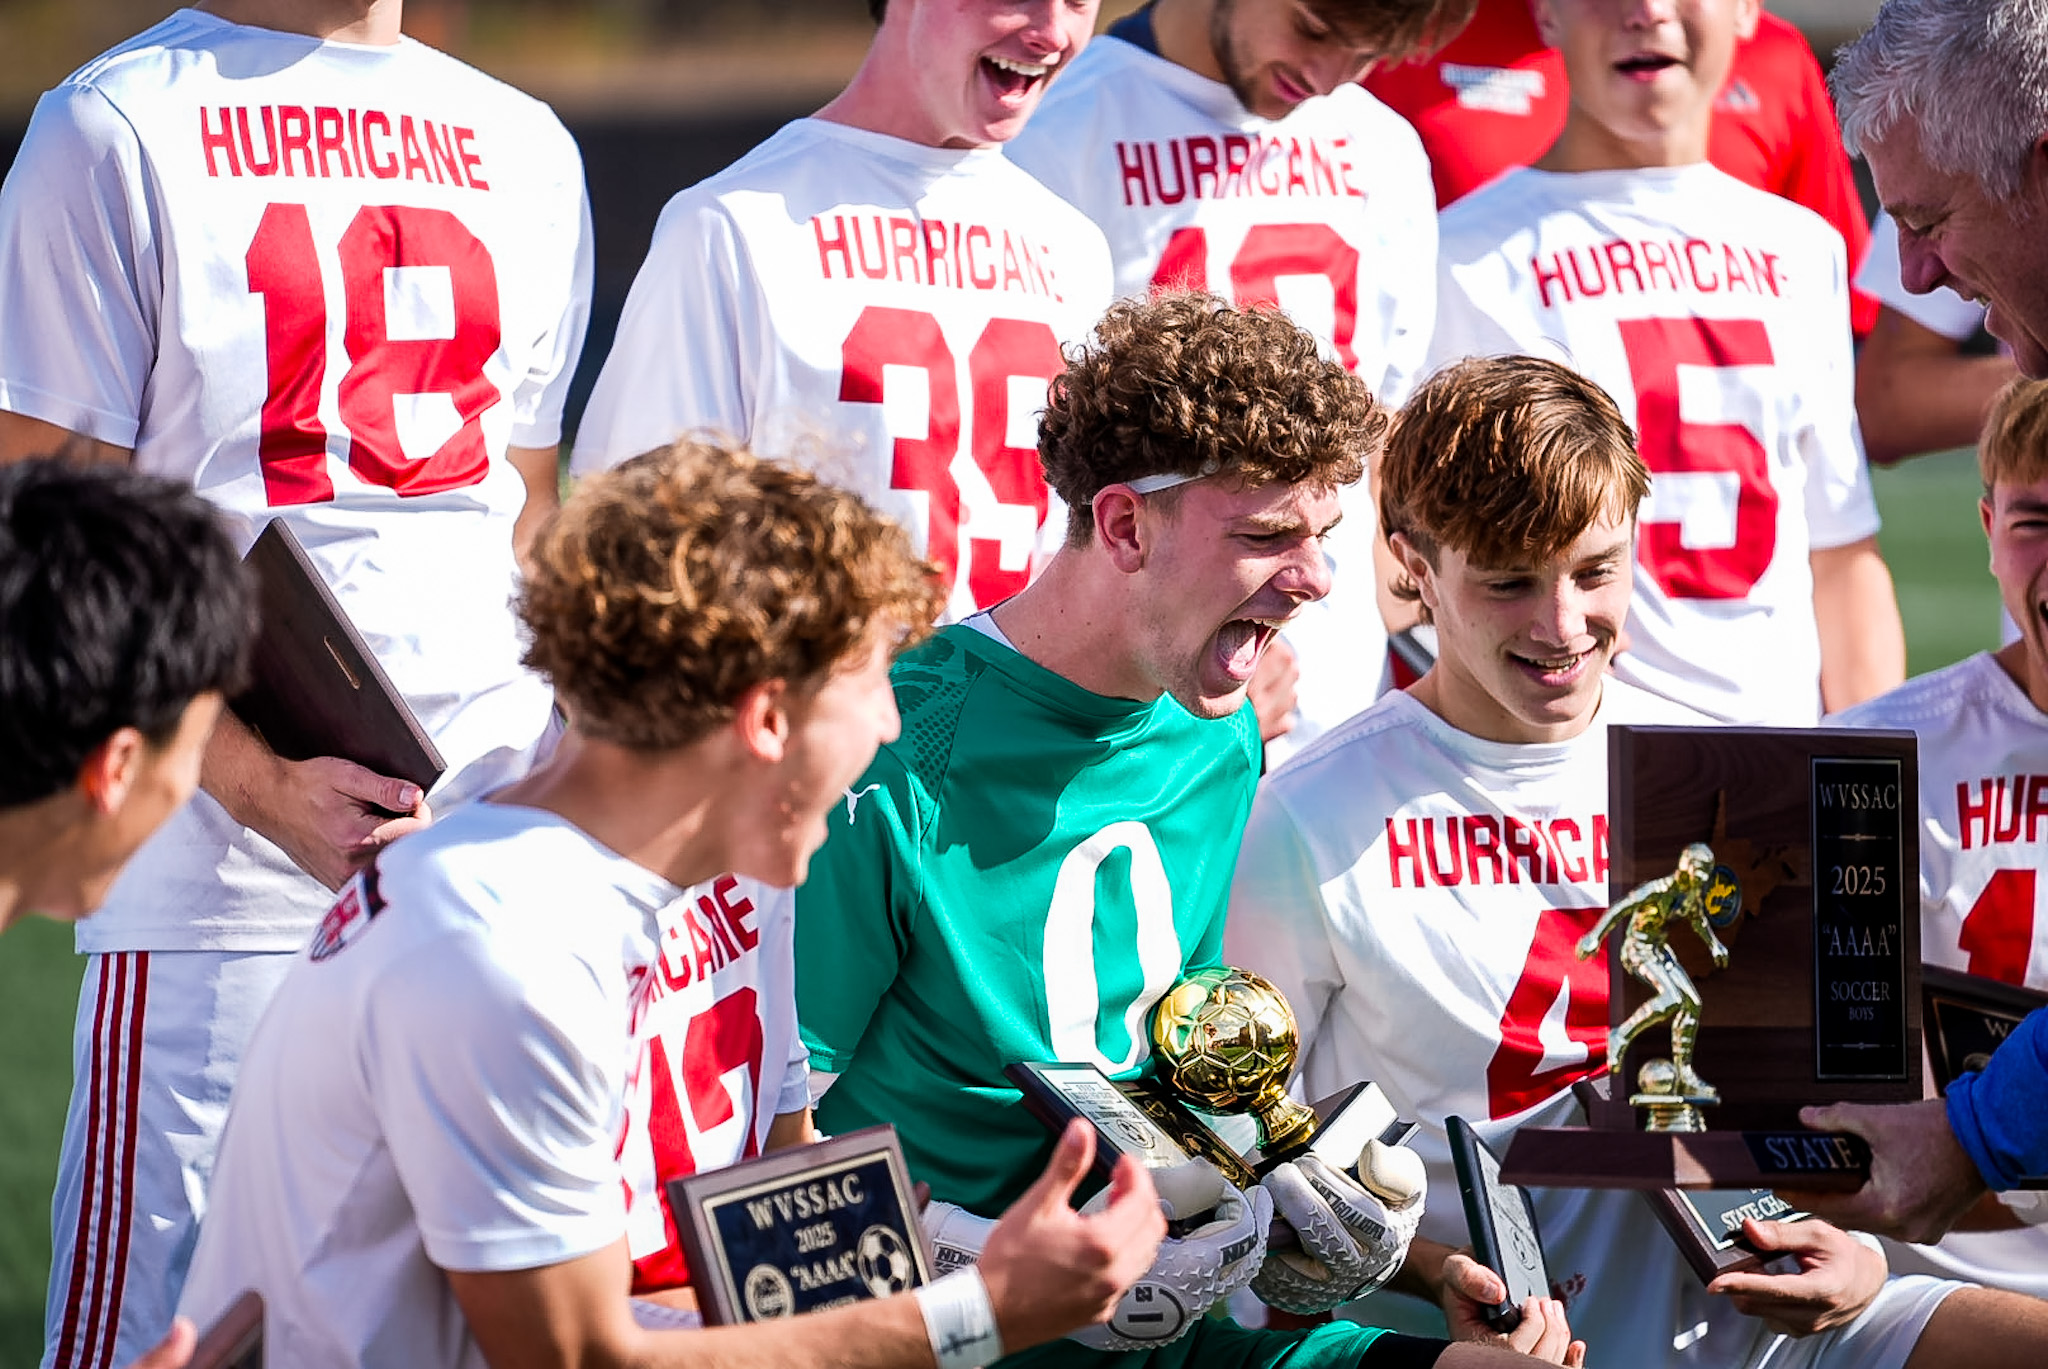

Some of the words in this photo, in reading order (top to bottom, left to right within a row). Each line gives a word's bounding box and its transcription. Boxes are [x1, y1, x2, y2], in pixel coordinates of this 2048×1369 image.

[201, 105, 489, 191] HURRICANE
[1116, 134, 1366, 207] HURRICANE
[1531, 238, 1790, 307] HURRICAN
[246, 202, 501, 507] 18
[840, 305, 1064, 610] 39
[1617, 316, 1778, 600] 5
[1819, 783, 1896, 810] WVSSAC
[1830, 865, 1886, 895] 2025
[1042, 820, 1181, 1075] 0
[1830, 981, 1890, 1001] SOCCER
[1848, 1006, 1875, 1021] BOYS
[1765, 1136, 1861, 1169] STATE
[745, 1173, 864, 1230] WVSSAC
[1720, 1201, 1761, 1232] STATE
[794, 1221, 837, 1253] 2025
